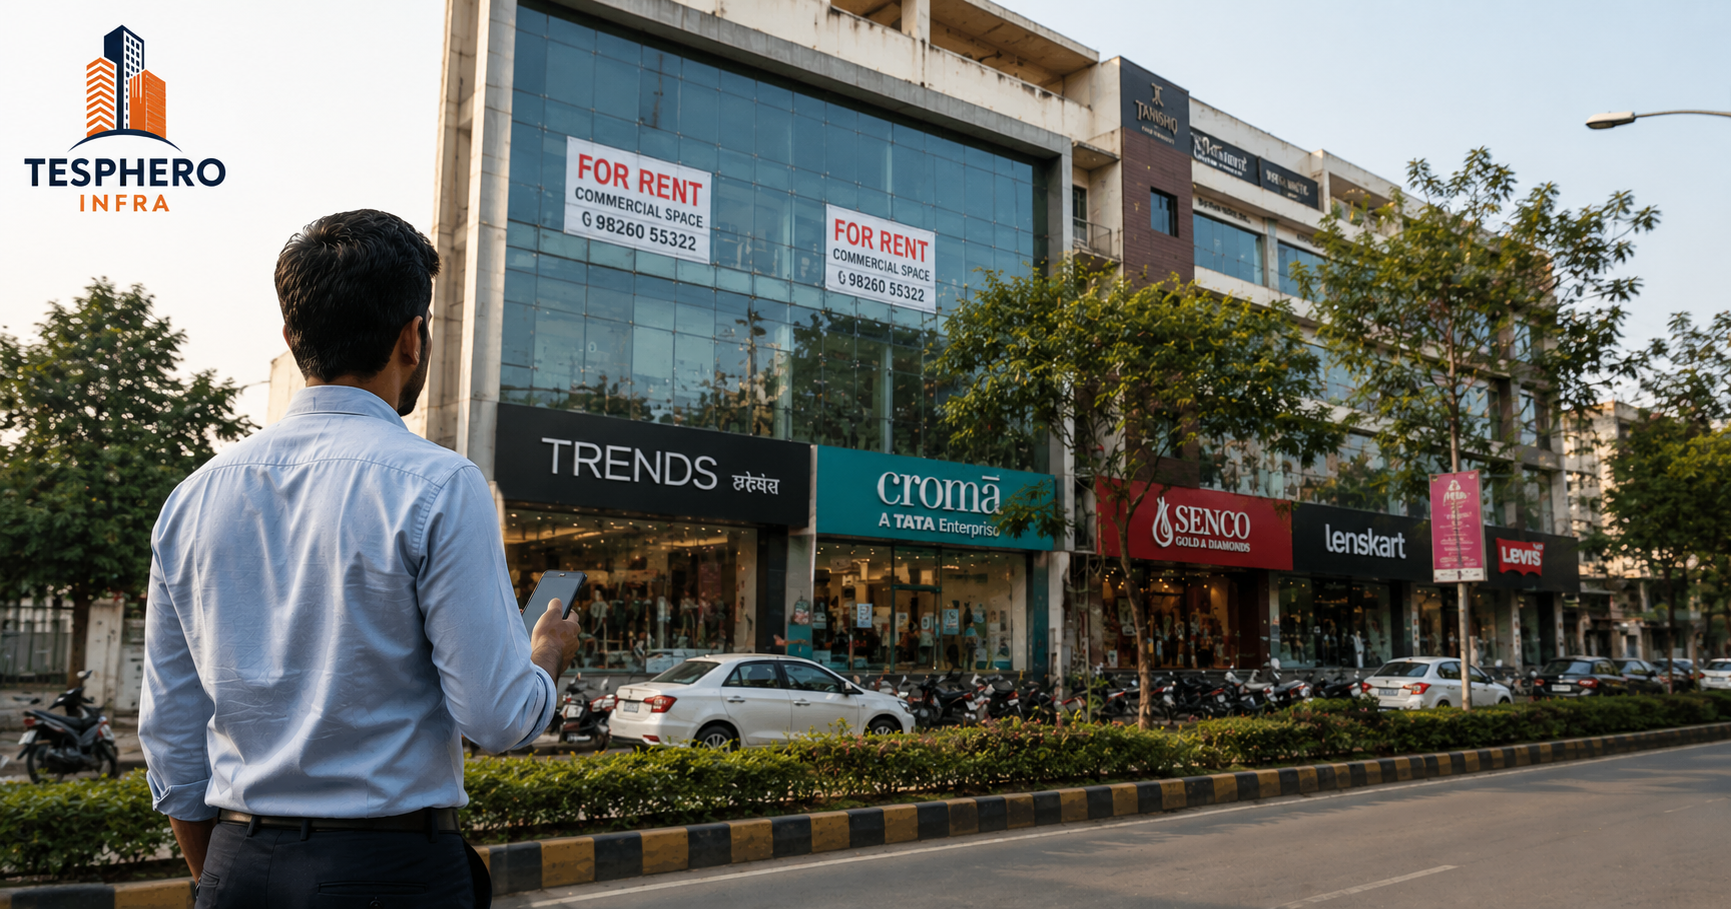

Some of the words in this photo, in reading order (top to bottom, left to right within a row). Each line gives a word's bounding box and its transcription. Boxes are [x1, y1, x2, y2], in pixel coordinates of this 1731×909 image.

[578, 153, 630, 190] FOR
[639, 168, 703, 207] RENT
[575, 186, 662, 219] COMMERCIAL
[665, 207, 704, 229] SPACE
[596, 214, 645, 239] 98260
[649, 227, 696, 251] 55322
[835, 218, 874, 249] FOR
[880, 230, 929, 262] RENT
[833, 248, 899, 274] COMMERCIAL
[901, 264, 930, 281] SPACE
[848, 272, 886, 293] 98260
[889, 282, 925, 302] 55322
[541, 437, 718, 491] TRENDS
[878, 512, 891, 527] A
[893, 513, 936, 531] TATA
[1175, 504, 1251, 540] SENCO
[1175, 535, 1200, 548] GOLD
[1208, 538, 1251, 553] DIAMONDS
